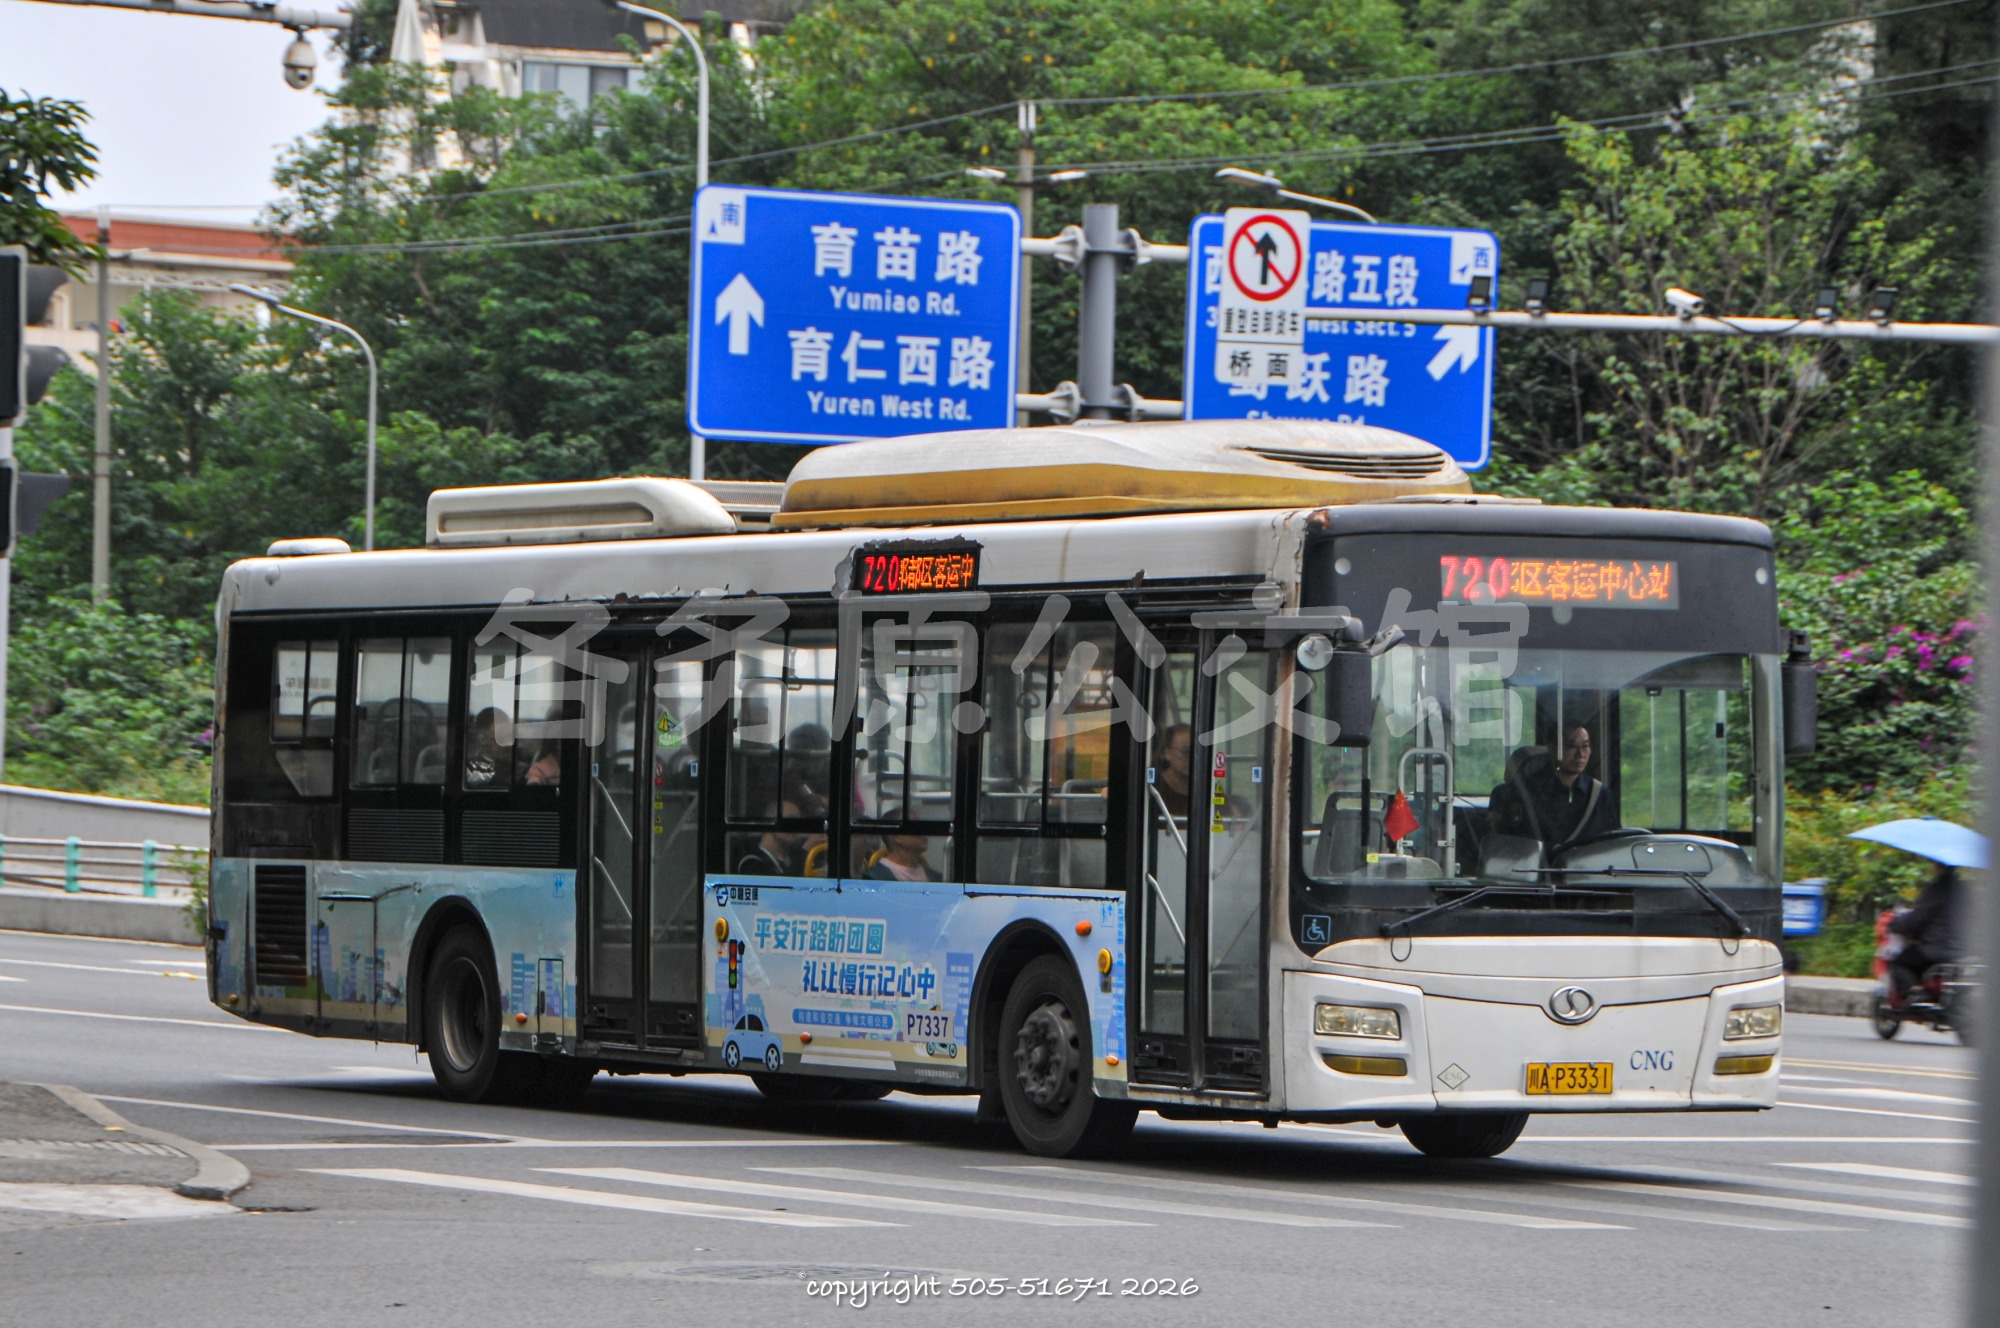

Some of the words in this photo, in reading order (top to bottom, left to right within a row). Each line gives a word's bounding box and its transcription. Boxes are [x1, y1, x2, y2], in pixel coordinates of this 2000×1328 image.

[720, 201, 741, 226] 南
[811, 222, 982, 286] 育苗路
[1473, 246, 1491, 268] 西
[830, 286, 920, 312] Yumiao
[927, 292, 960, 315] Rd.
[788, 327, 995, 390] 育仁西路
[1229, 350, 1291, 378] 桥面
[808, 391, 875, 416] Yuren
[882, 396, 933, 419] West
[940, 399, 972, 421] Rd.
[864, 555, 899, 592] 720
[1440, 556, 1510, 599] 720
[754, 918, 885, 955] 平安行路盼团圆
[803, 960, 936, 1000] 礼让慢行记心中
[907, 1013, 948, 1037] P7337
[1630, 1049, 1674, 1071] CNG
